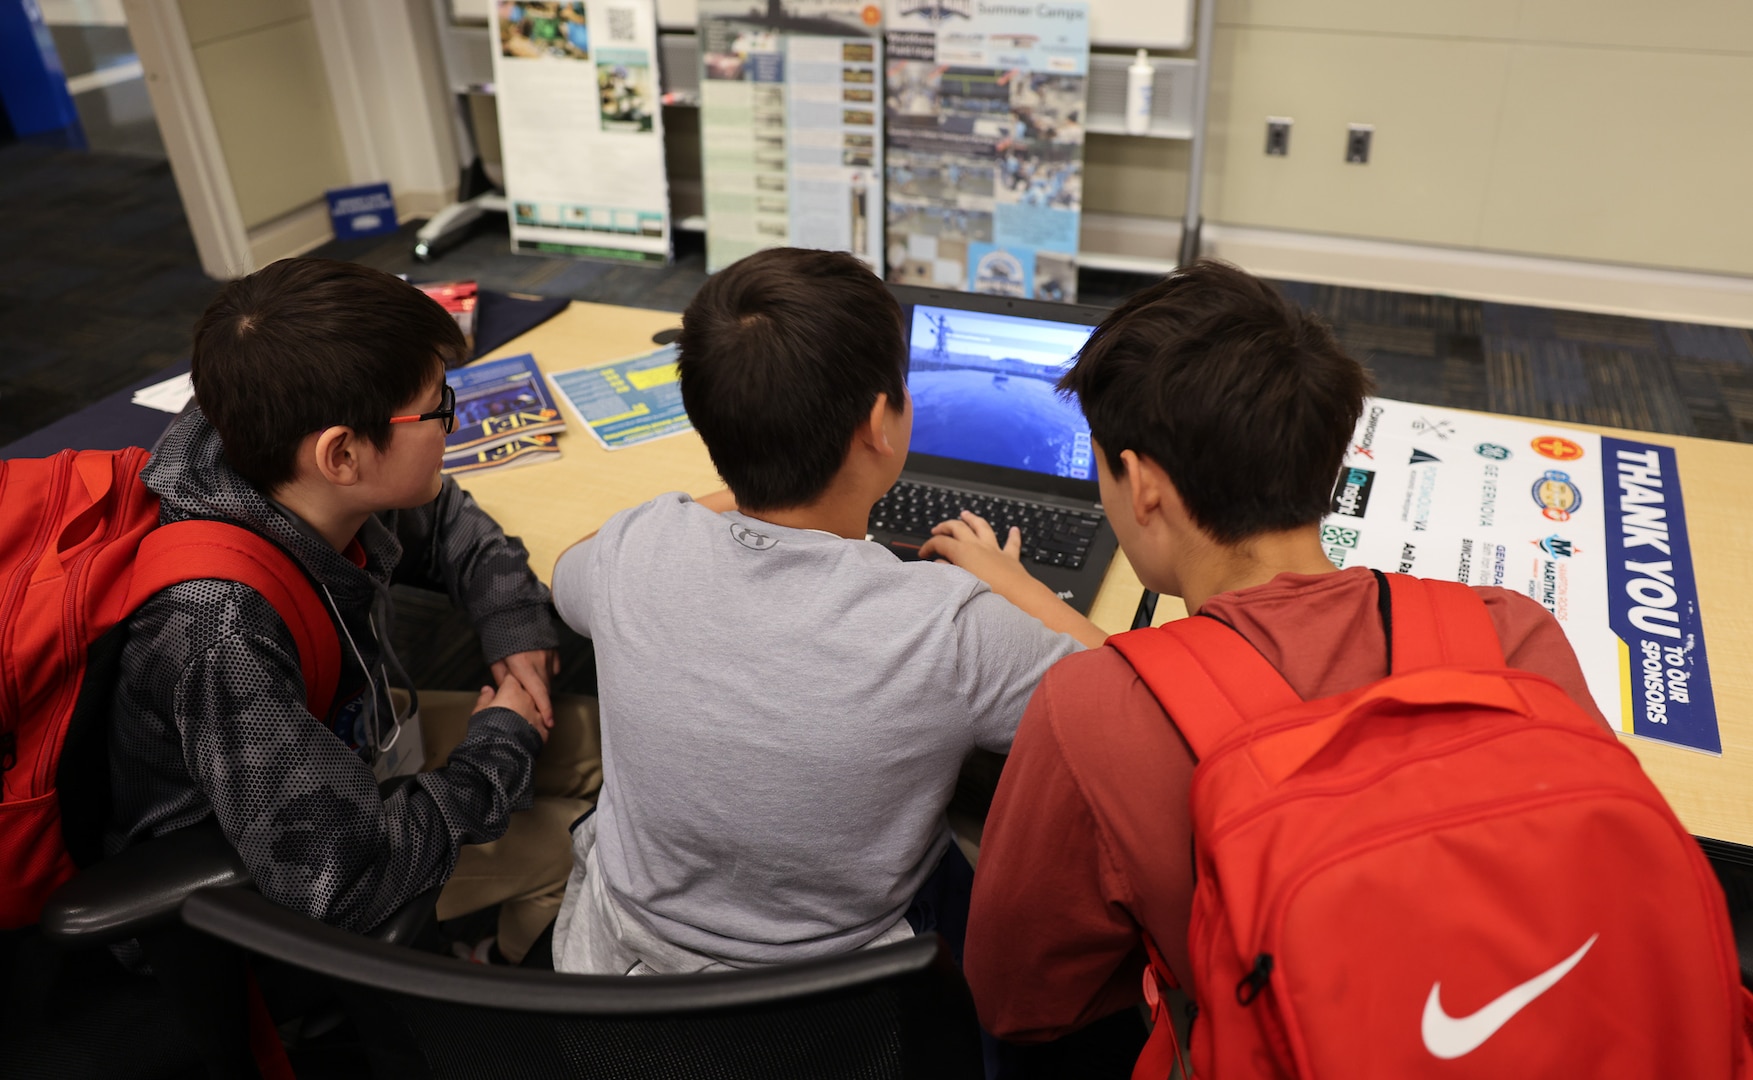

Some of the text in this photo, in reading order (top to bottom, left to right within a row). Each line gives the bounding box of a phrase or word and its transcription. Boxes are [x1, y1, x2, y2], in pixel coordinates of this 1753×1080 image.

[1484, 464, 1499, 478] GE
[1479, 479, 1498, 527] VERNOVA
[1395, 542, 1417, 574] Anil Ra
[1616, 450, 1681, 639] THANK YOU
[1543, 560, 1556, 605] MARITIME
[1558, 596, 1568, 621] ROADS
[1640, 640, 1667, 724] SPONSORS
[1664, 646, 1690, 703] TO OUR
